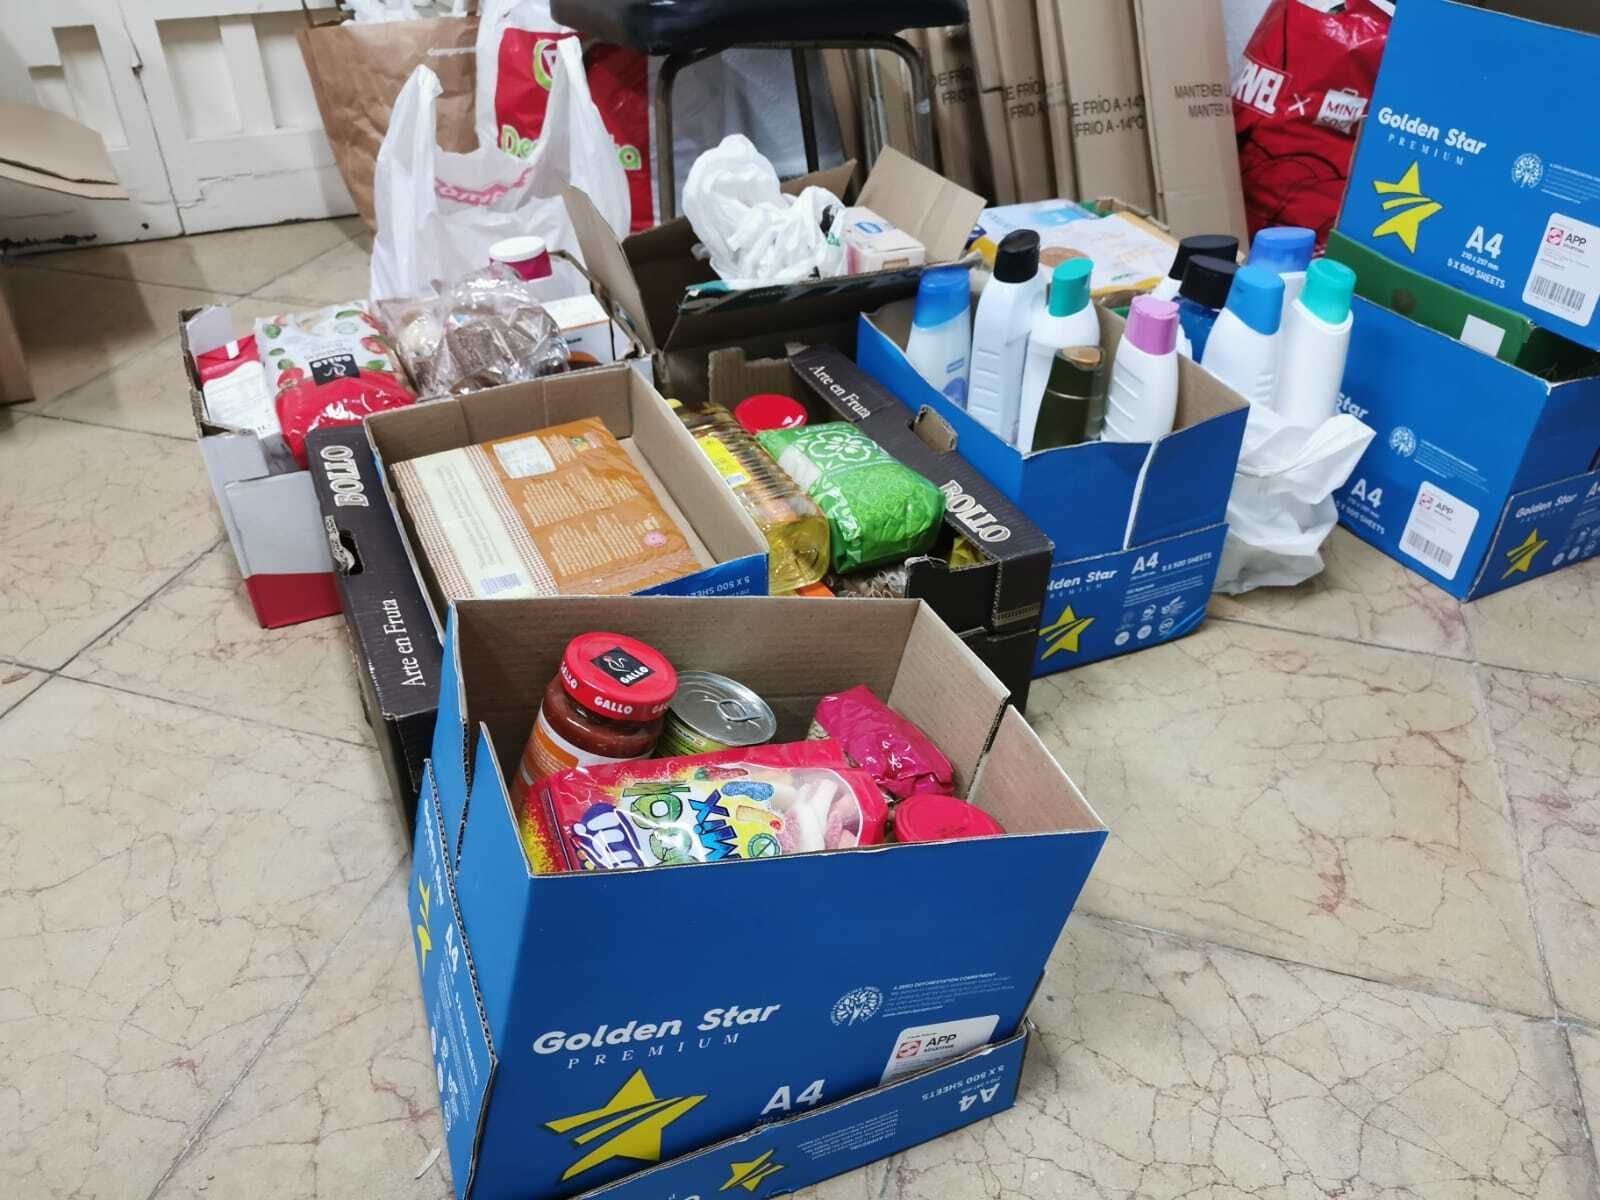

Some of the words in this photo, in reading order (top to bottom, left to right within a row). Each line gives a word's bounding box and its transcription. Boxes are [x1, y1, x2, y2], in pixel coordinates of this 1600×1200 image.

[1378, 106, 1440, 141] Golden
[1444, 128, 1488, 155] Star
[1387, 132, 1465, 167] PREMIUM
[1465, 224, 1504, 260] A4
[1565, 233, 1588, 247] APP
[1475, 269, 1506, 289] SHEETS
[320, 444, 371, 508] BOLLO
[1351, 477, 1384, 508] A4
[938, 479, 1012, 543] BOLLO
[1130, 551, 1160, 575] A4
[1047, 576, 1081, 592] lden
[1085, 569, 1118, 583] Star
[382, 598, 408, 635] Fruta
[394, 636, 414, 655] en
[401, 656, 427, 687] Arte
[620, 665, 650, 684] GALLO
[594, 695, 633, 715] GALLO
[532, 1019, 684, 1055] Golden
[697, 1003, 782, 1031] Star
[925, 1033, 957, 1048] APP
[567, 1032, 740, 1070] PREMIUM
[758, 1079, 826, 1116] A4
[958, 1082, 1001, 1113] A4
